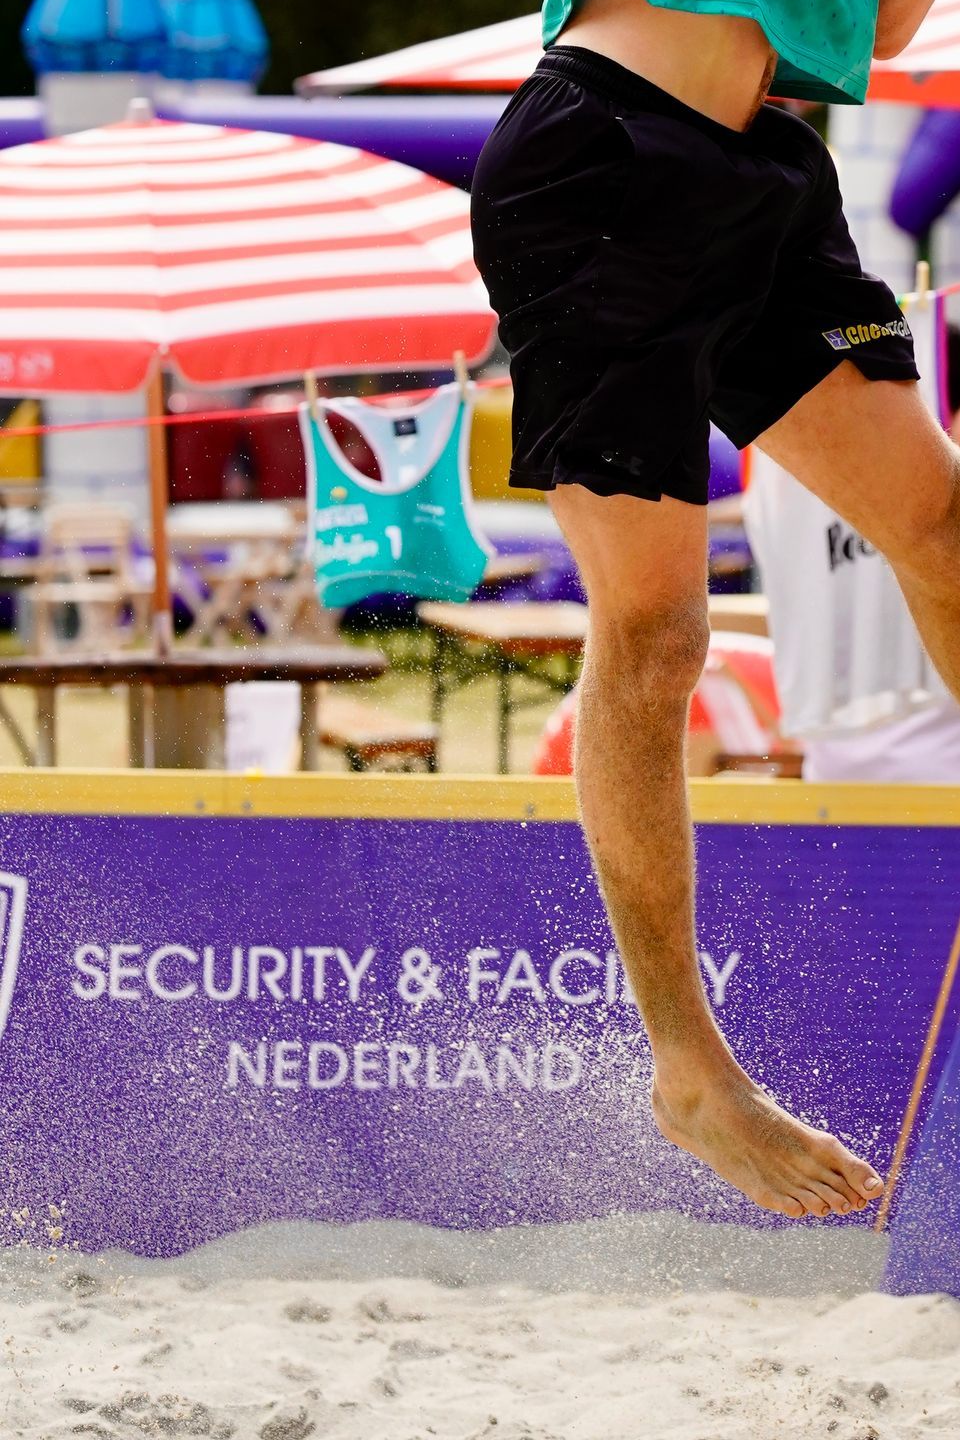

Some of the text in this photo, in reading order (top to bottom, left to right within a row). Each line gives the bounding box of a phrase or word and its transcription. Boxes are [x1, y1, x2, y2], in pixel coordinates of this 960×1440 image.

[71, 943, 741, 1007] SECURITY & FACIY
[225, 1040, 582, 1091] NEDERLAND
